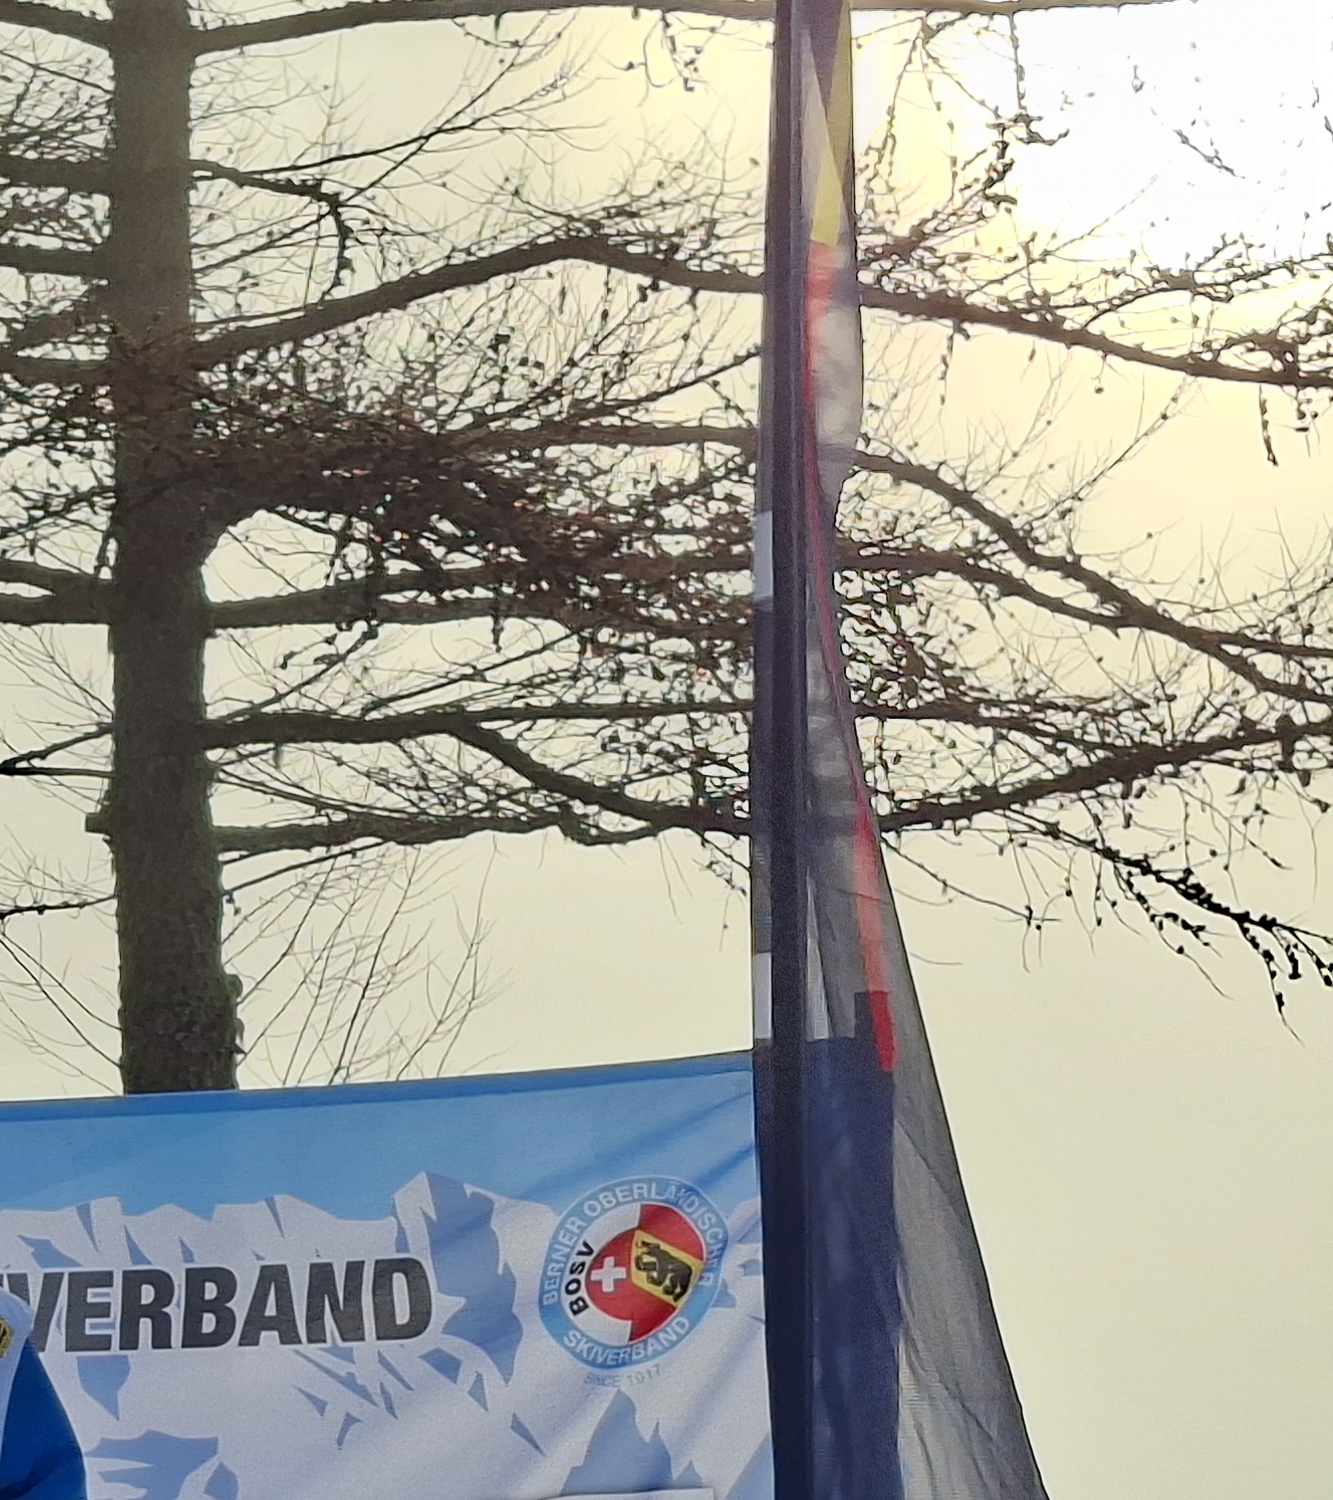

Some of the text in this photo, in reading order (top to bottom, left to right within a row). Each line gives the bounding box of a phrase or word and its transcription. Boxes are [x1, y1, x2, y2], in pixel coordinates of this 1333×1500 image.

[543, 1216, 588, 1305] BERNER
[564, 1241, 594, 1316] BOSV
[563, 1316, 690, 1366] SKIVERBAND
